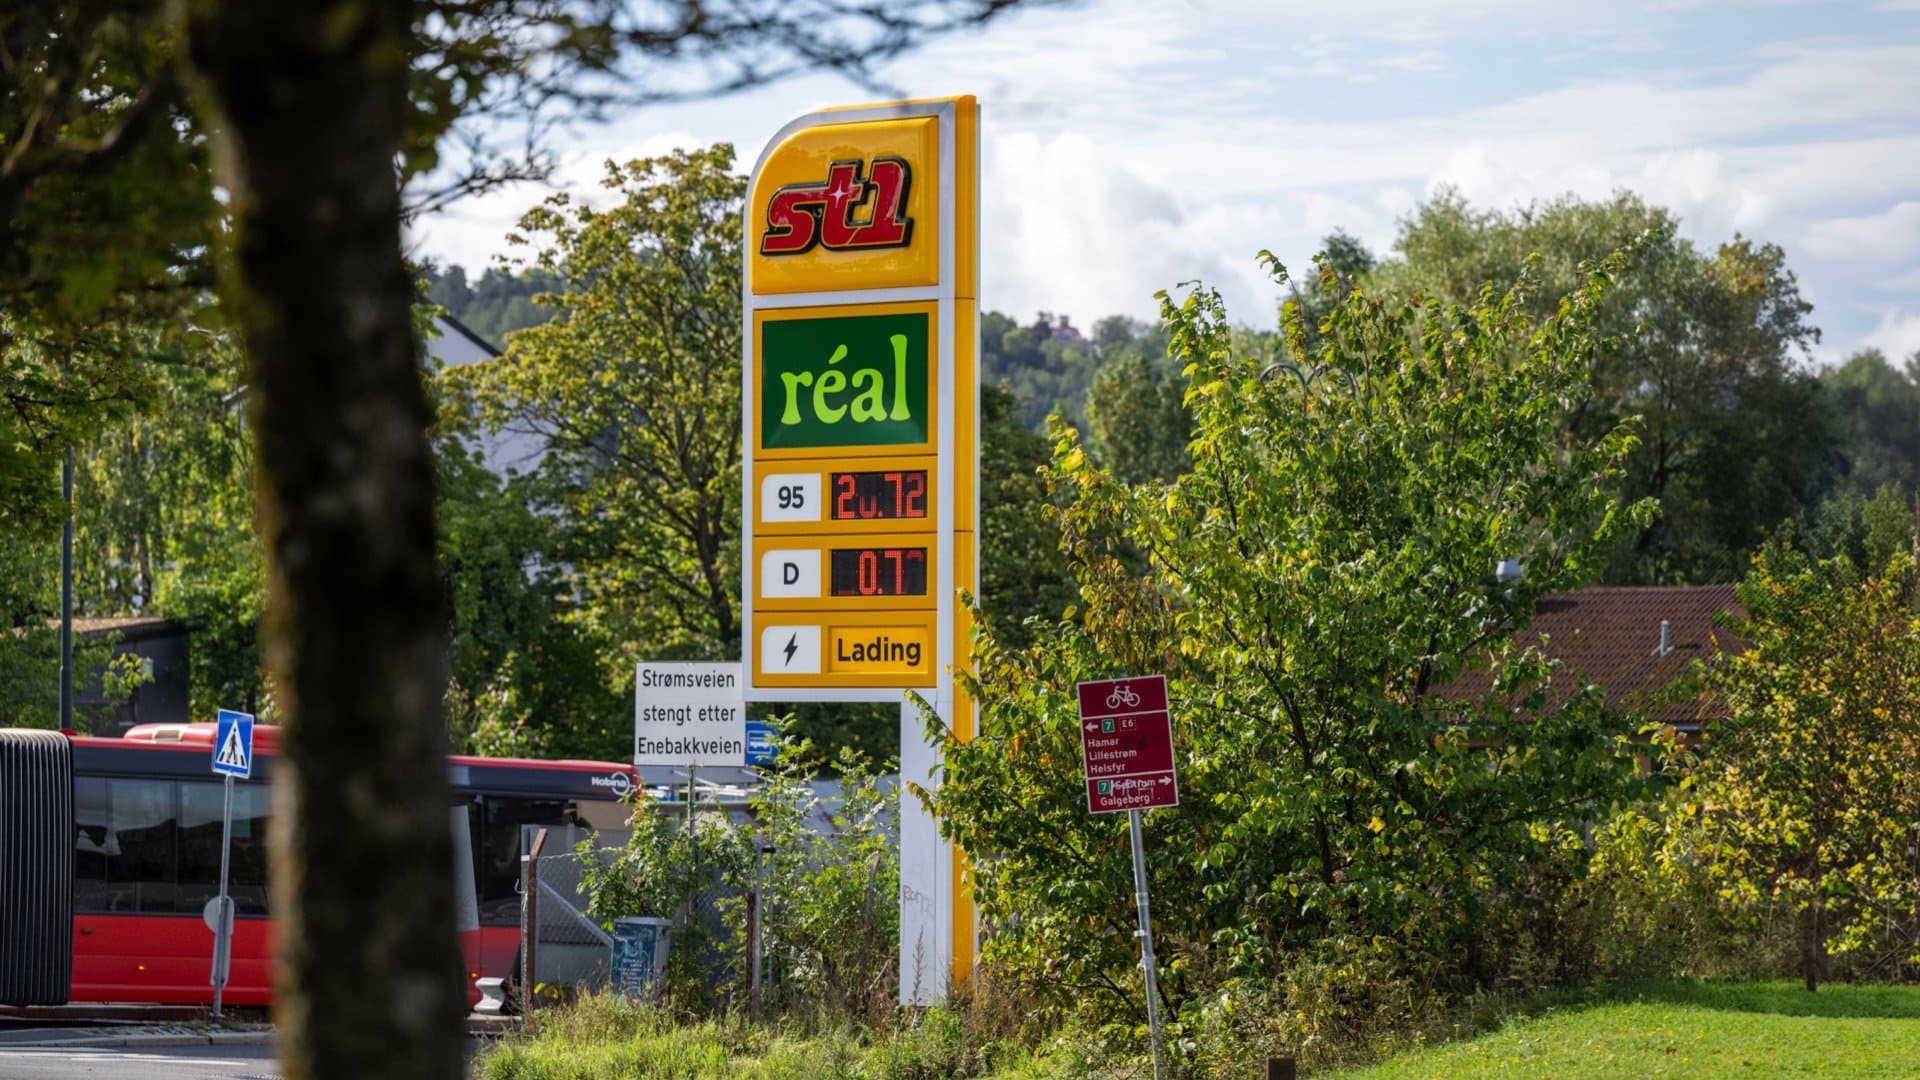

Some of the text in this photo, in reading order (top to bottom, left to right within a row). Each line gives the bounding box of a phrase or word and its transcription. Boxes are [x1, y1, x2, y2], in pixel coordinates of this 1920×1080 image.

[780, 335, 911, 425] réal
[778, 486, 805, 509] 95
[783, 550, 924, 596] D 0.7
[838, 637, 921, 666] Lading
[642, 669, 735, 688] Strømsveien
[643, 705, 736, 726] stengt etter
[1103, 719, 1134, 731] 7 E6
[638, 737, 742, 755] Enebakkveien
[1088, 738, 1120, 748] Hamar
[1089, 749, 1137, 761] Lillestrøm
[1090, 763, 1126, 774] Helsfyr
[1101, 783, 1108, 792] 7
[1100, 795, 1150, 807] Galgeberg
